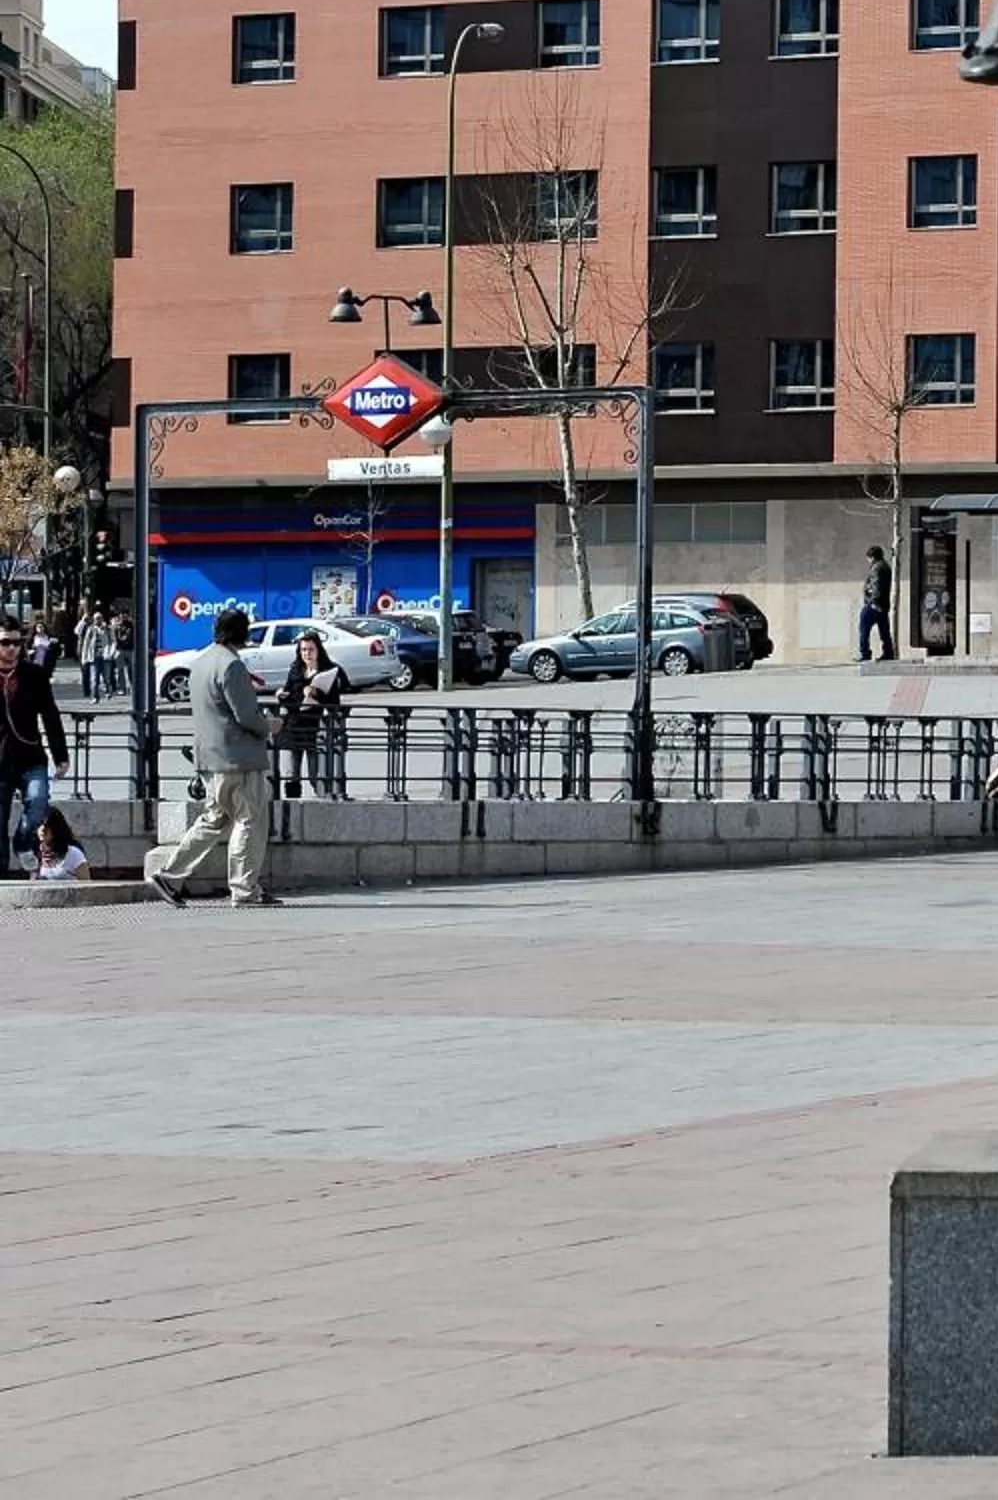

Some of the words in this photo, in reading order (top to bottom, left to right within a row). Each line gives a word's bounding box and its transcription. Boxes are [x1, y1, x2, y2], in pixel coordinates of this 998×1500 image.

[354, 391, 406, 411] Metro
[360, 462, 412, 476] Ventas
[313, 513, 363, 528] OpenCor
[174, 596, 257, 621] OpenCor
